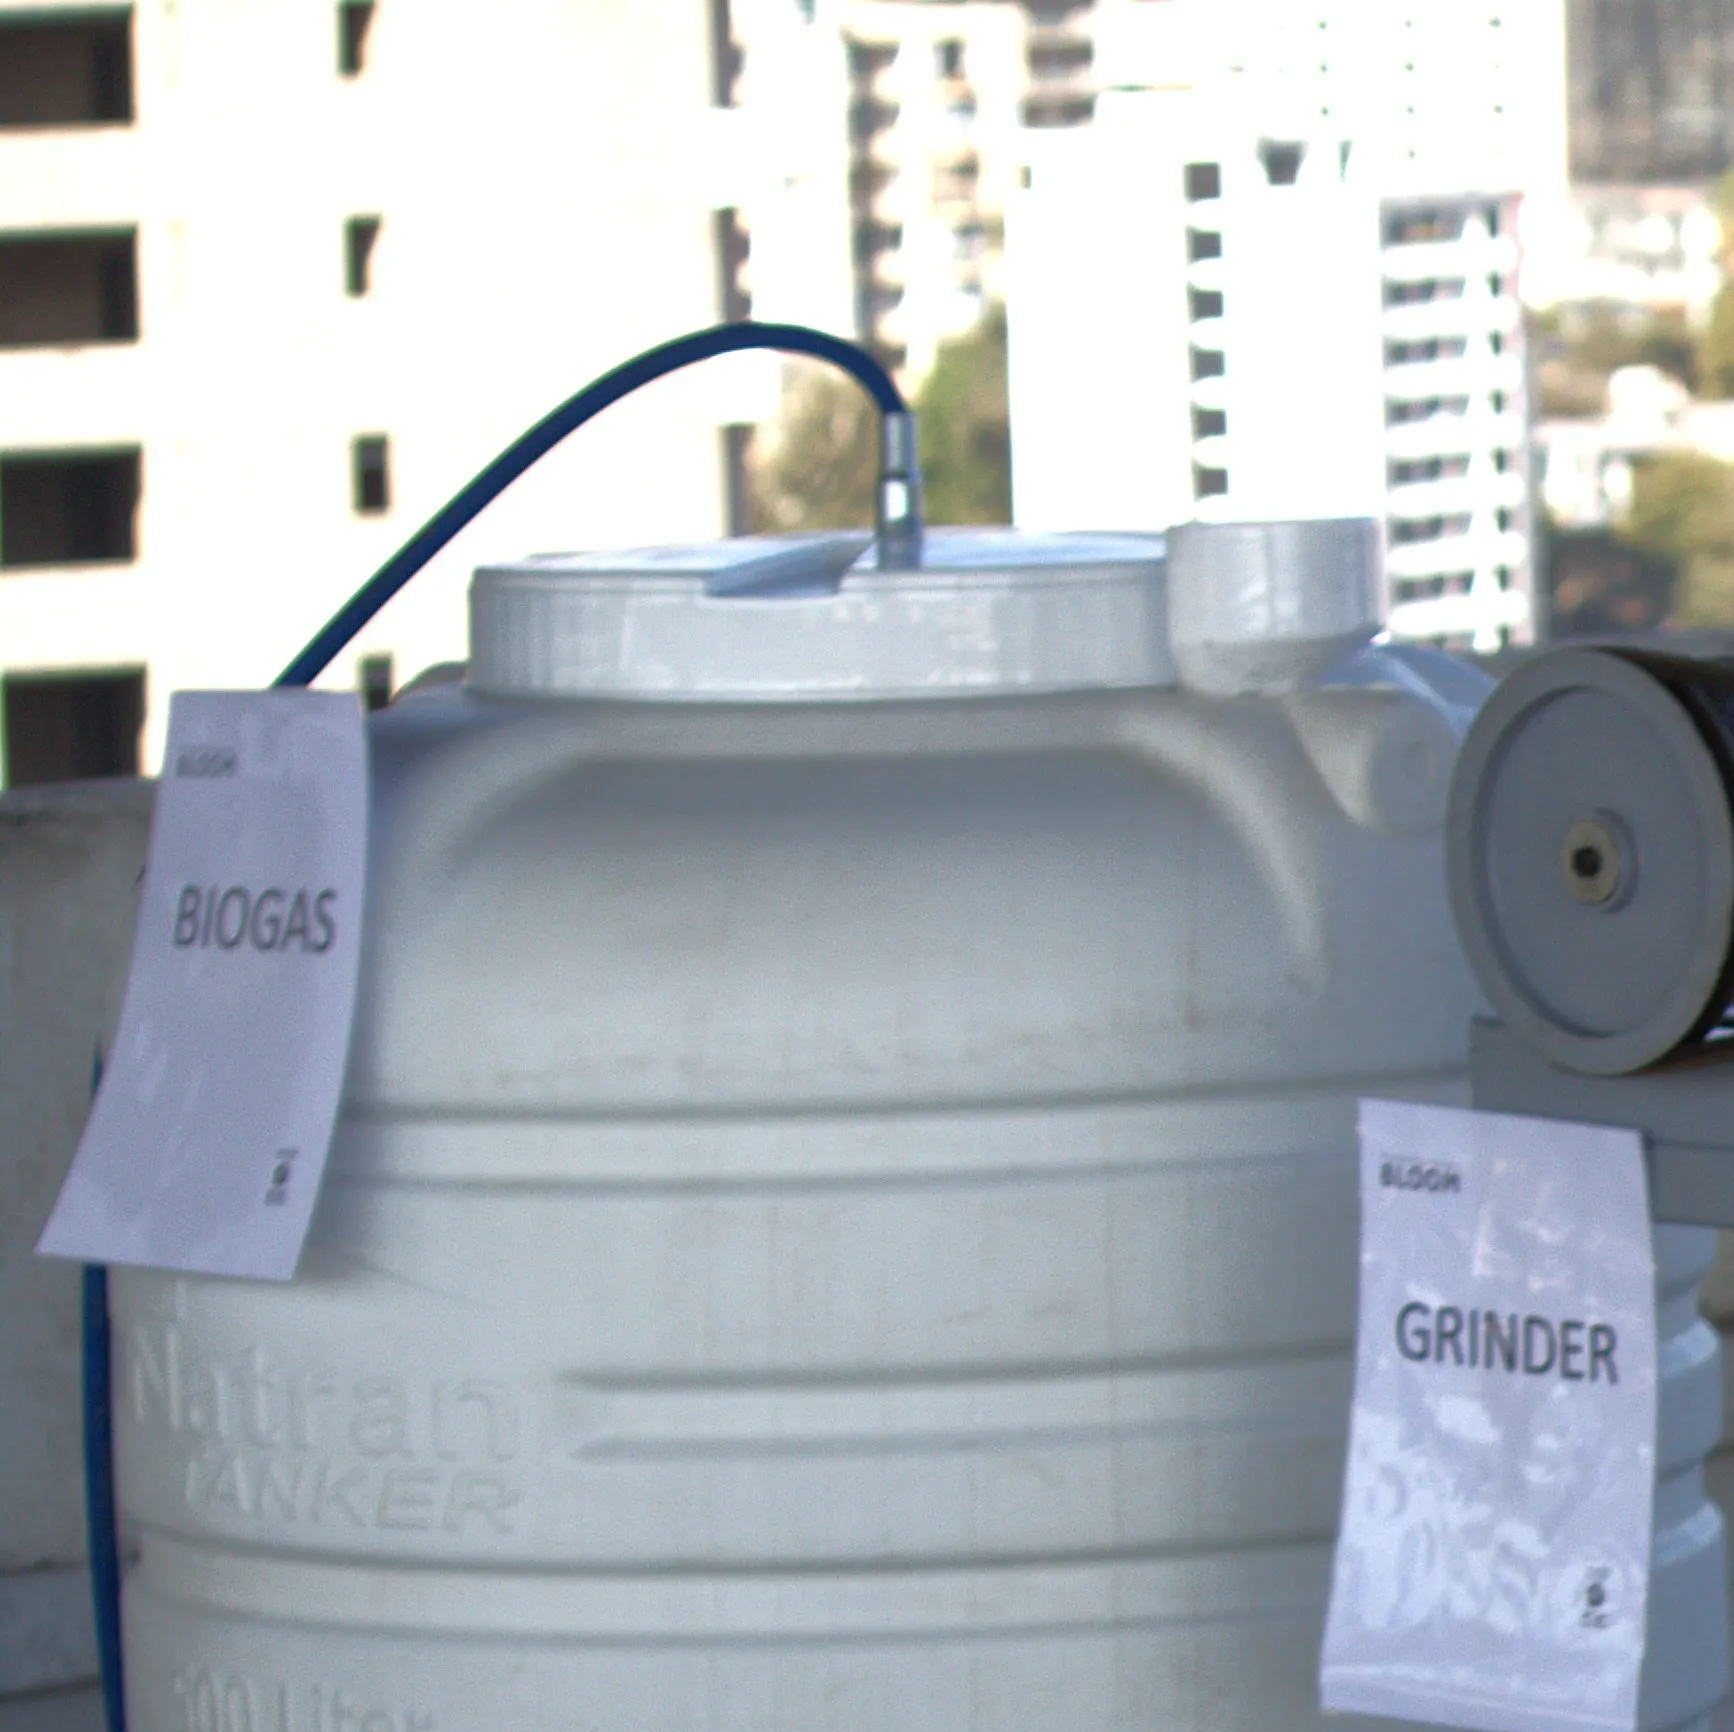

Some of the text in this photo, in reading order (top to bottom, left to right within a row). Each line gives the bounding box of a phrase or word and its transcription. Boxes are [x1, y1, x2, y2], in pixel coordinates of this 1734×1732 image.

[171, 885, 338, 954] BIOGAS
[1379, 1161, 1461, 1194] BLOOM
[1395, 1301, 1619, 1385] GRINDER
